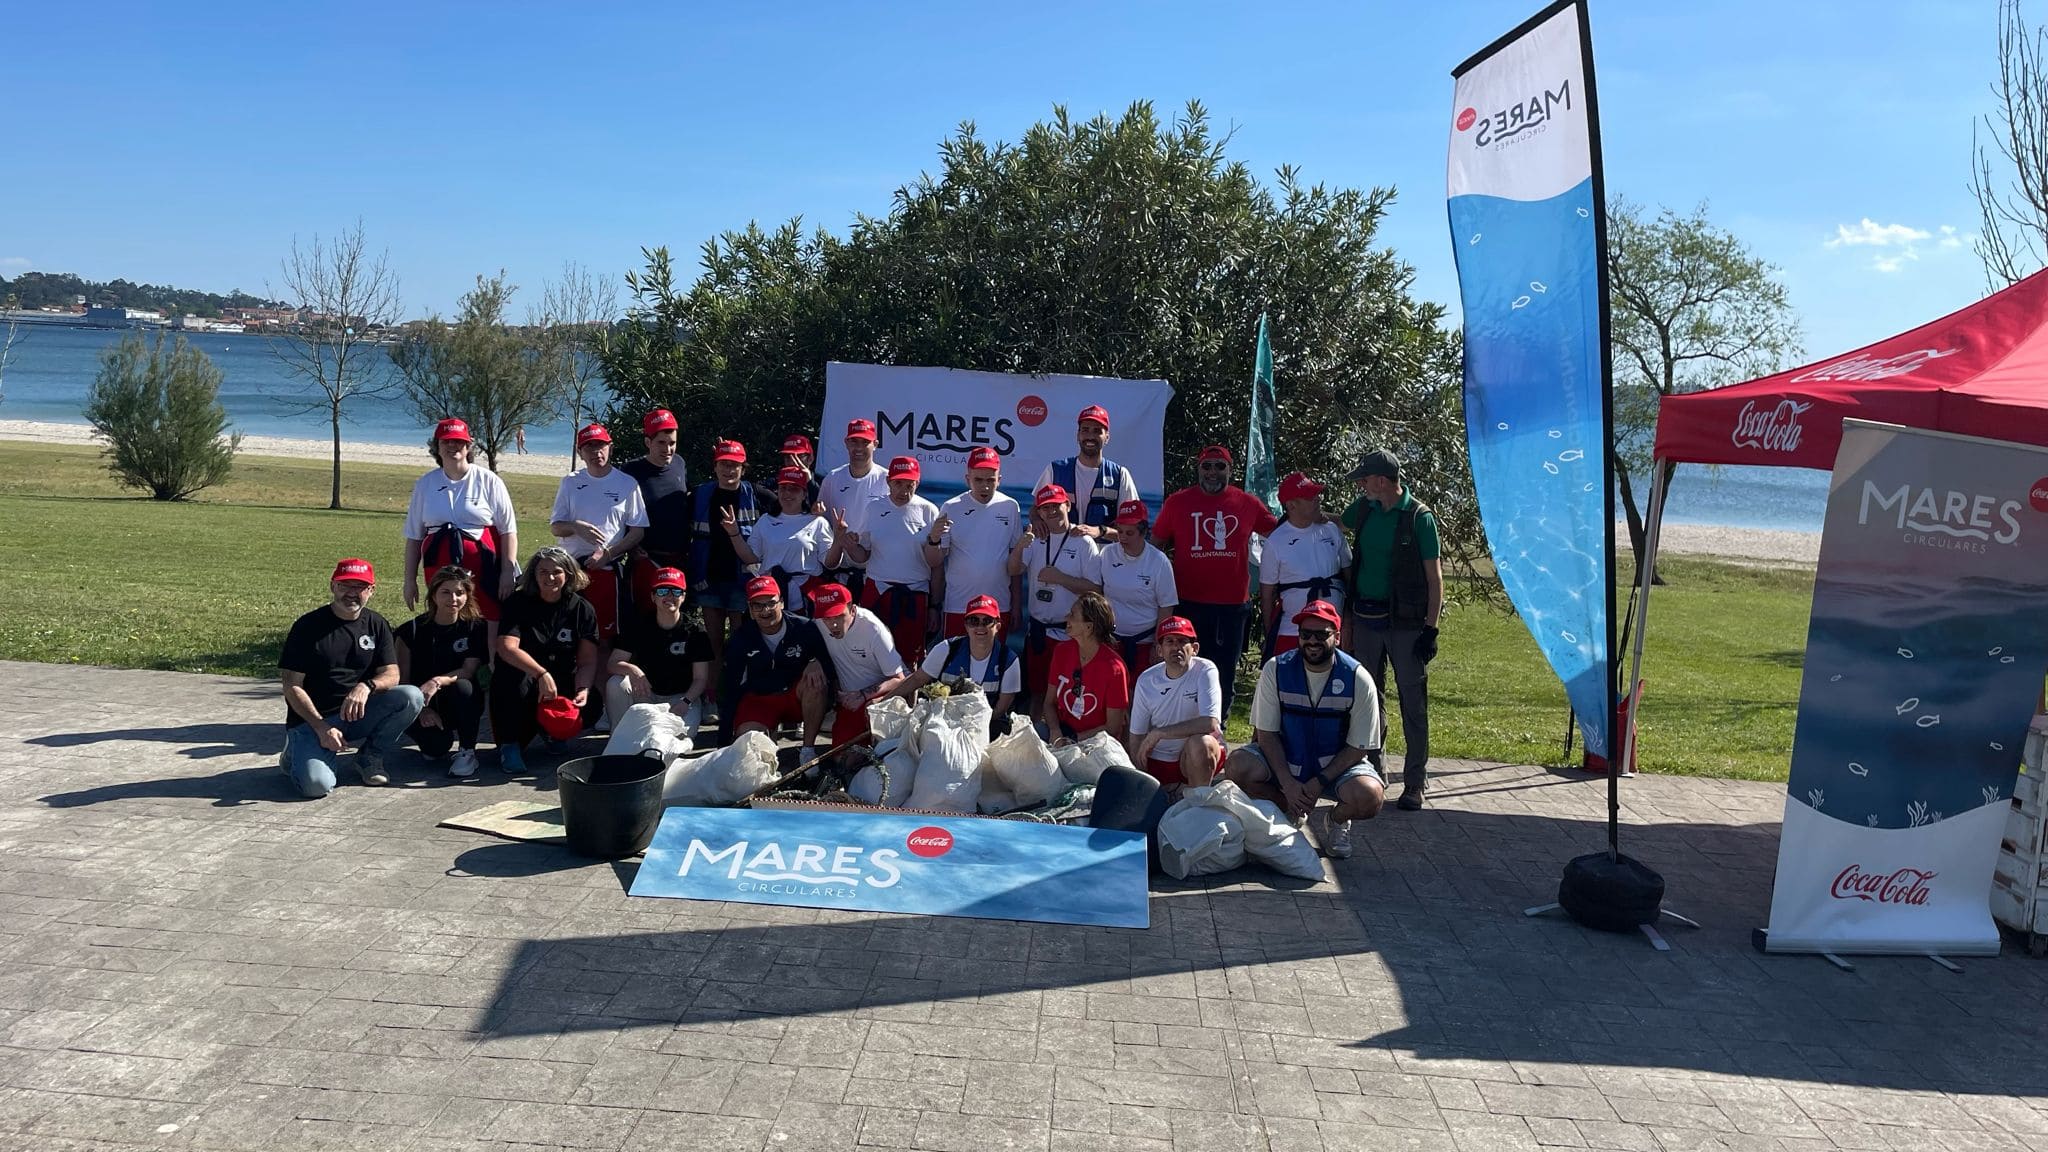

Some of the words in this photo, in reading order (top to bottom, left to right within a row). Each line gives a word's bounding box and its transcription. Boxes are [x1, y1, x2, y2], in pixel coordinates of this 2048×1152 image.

[876, 410, 1015, 456] MARES
[1732, 399, 1814, 452] Coca-Cola
[916, 453, 967, 465] CIRCULA
[1858, 479, 2022, 544] MARES
[1903, 533, 1987, 555] CIRCULARES
[678, 839, 901, 888] MARES
[910, 836, 950, 848] Coca-Cola
[738, 882, 857, 899] CIRCULARES
[1830, 863, 1939, 906] Coca-Cola
